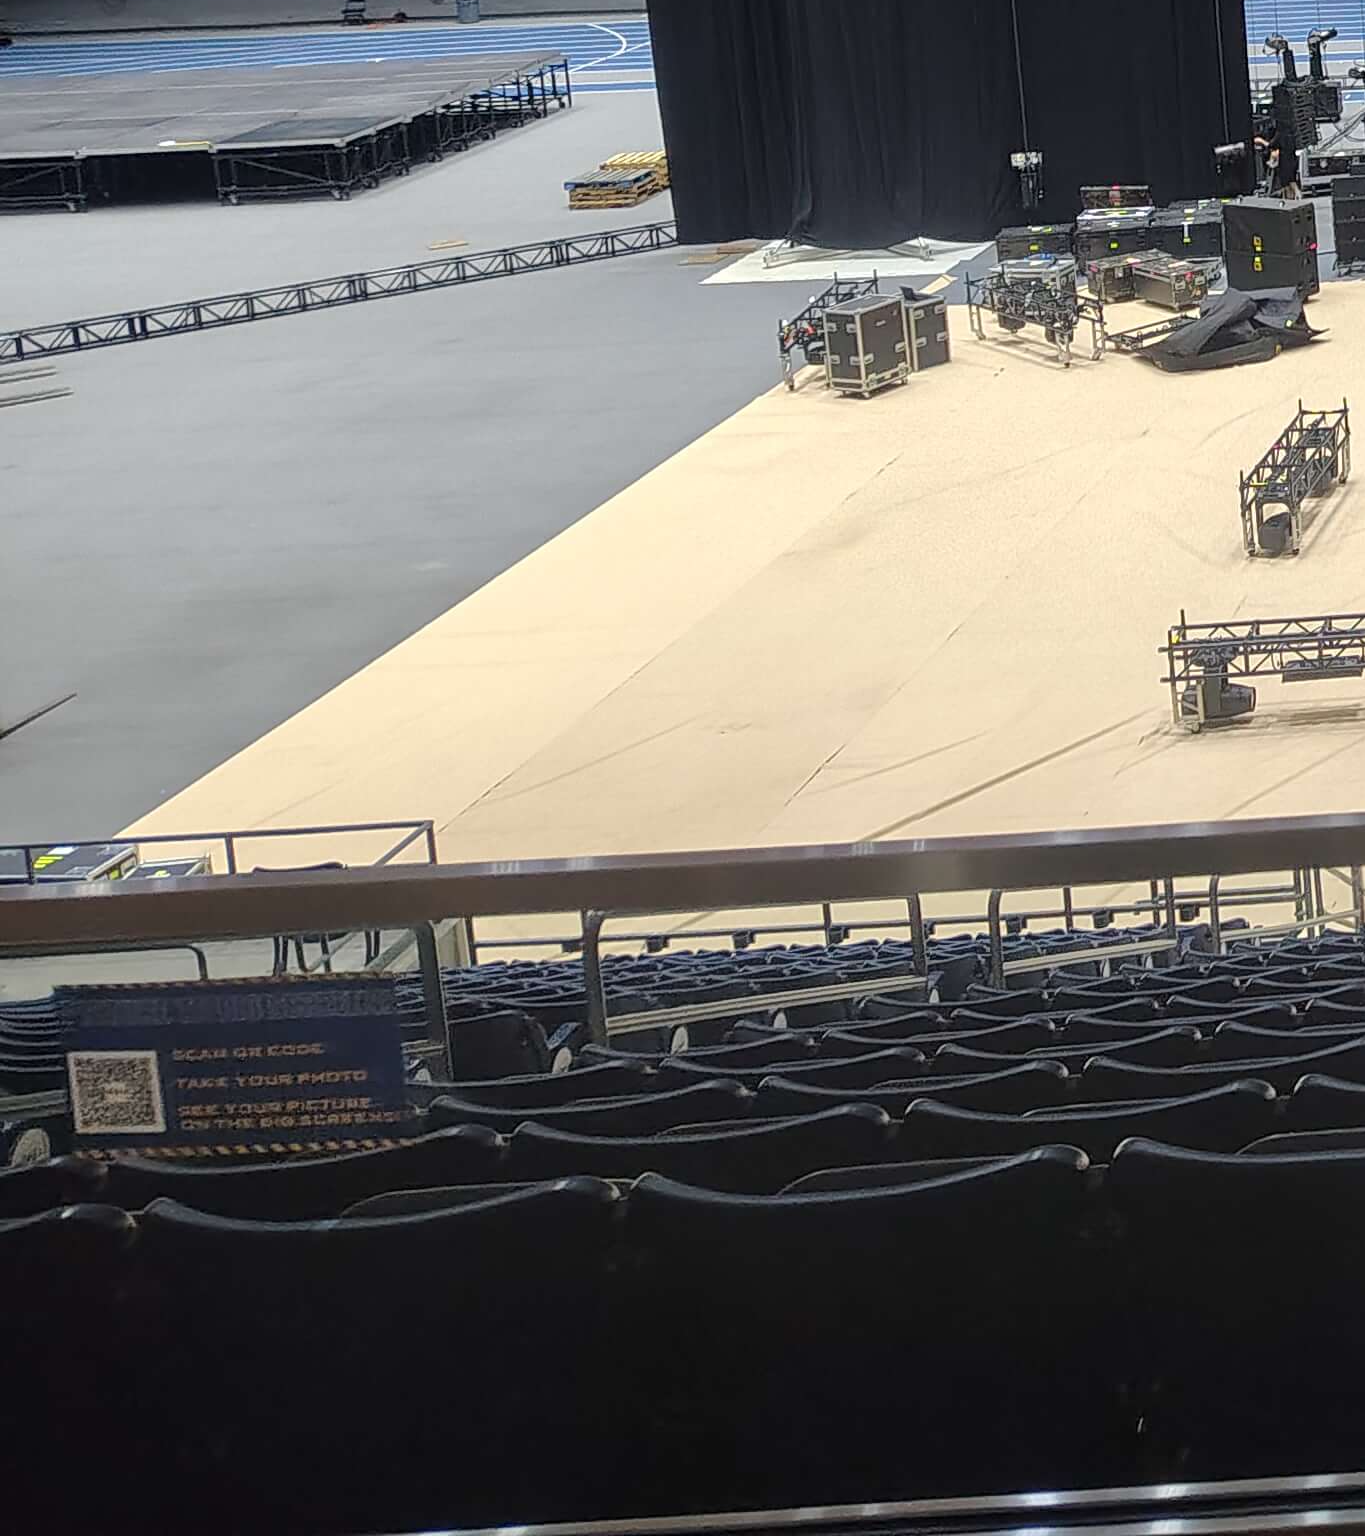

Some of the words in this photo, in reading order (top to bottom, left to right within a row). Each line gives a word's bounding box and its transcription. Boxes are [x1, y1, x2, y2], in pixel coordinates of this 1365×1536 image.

[173, 1048, 227, 1061] SCAN
[267, 1043, 324, 1057] CODE
[176, 1077, 228, 1089] TAKE
[237, 1074, 293, 1087] YOUR
[297, 1070, 368, 1085] PHOTO
[224, 1103, 282, 1114] YOUR
[286, 1097, 370, 1110] PICTURE
